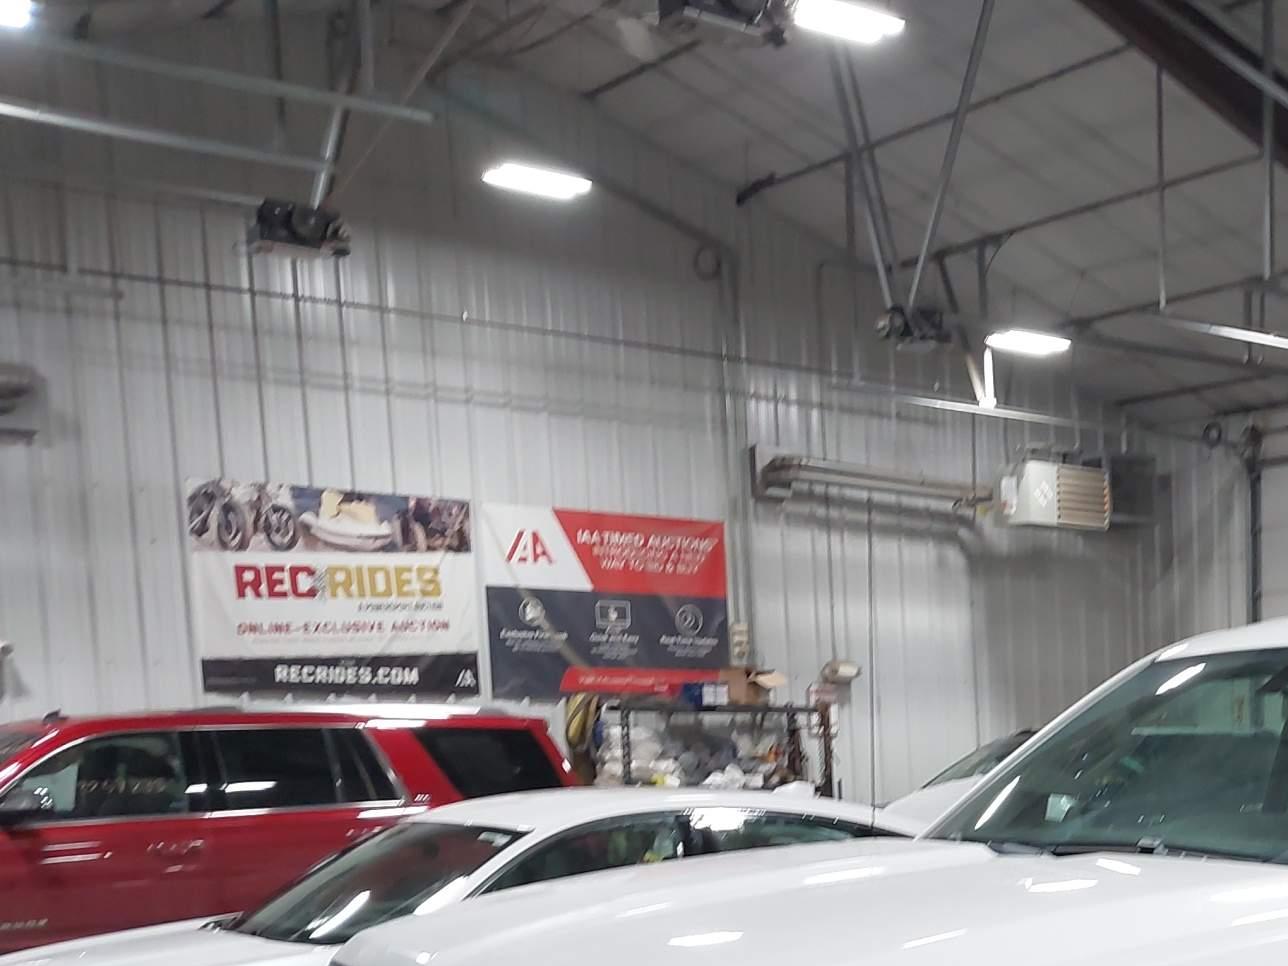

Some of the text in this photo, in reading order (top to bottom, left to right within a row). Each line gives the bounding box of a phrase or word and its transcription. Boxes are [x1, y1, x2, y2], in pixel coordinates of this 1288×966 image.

[234, 564, 442, 599] REC RIDES
[273, 664, 420, 685] RECRIDES.COM
